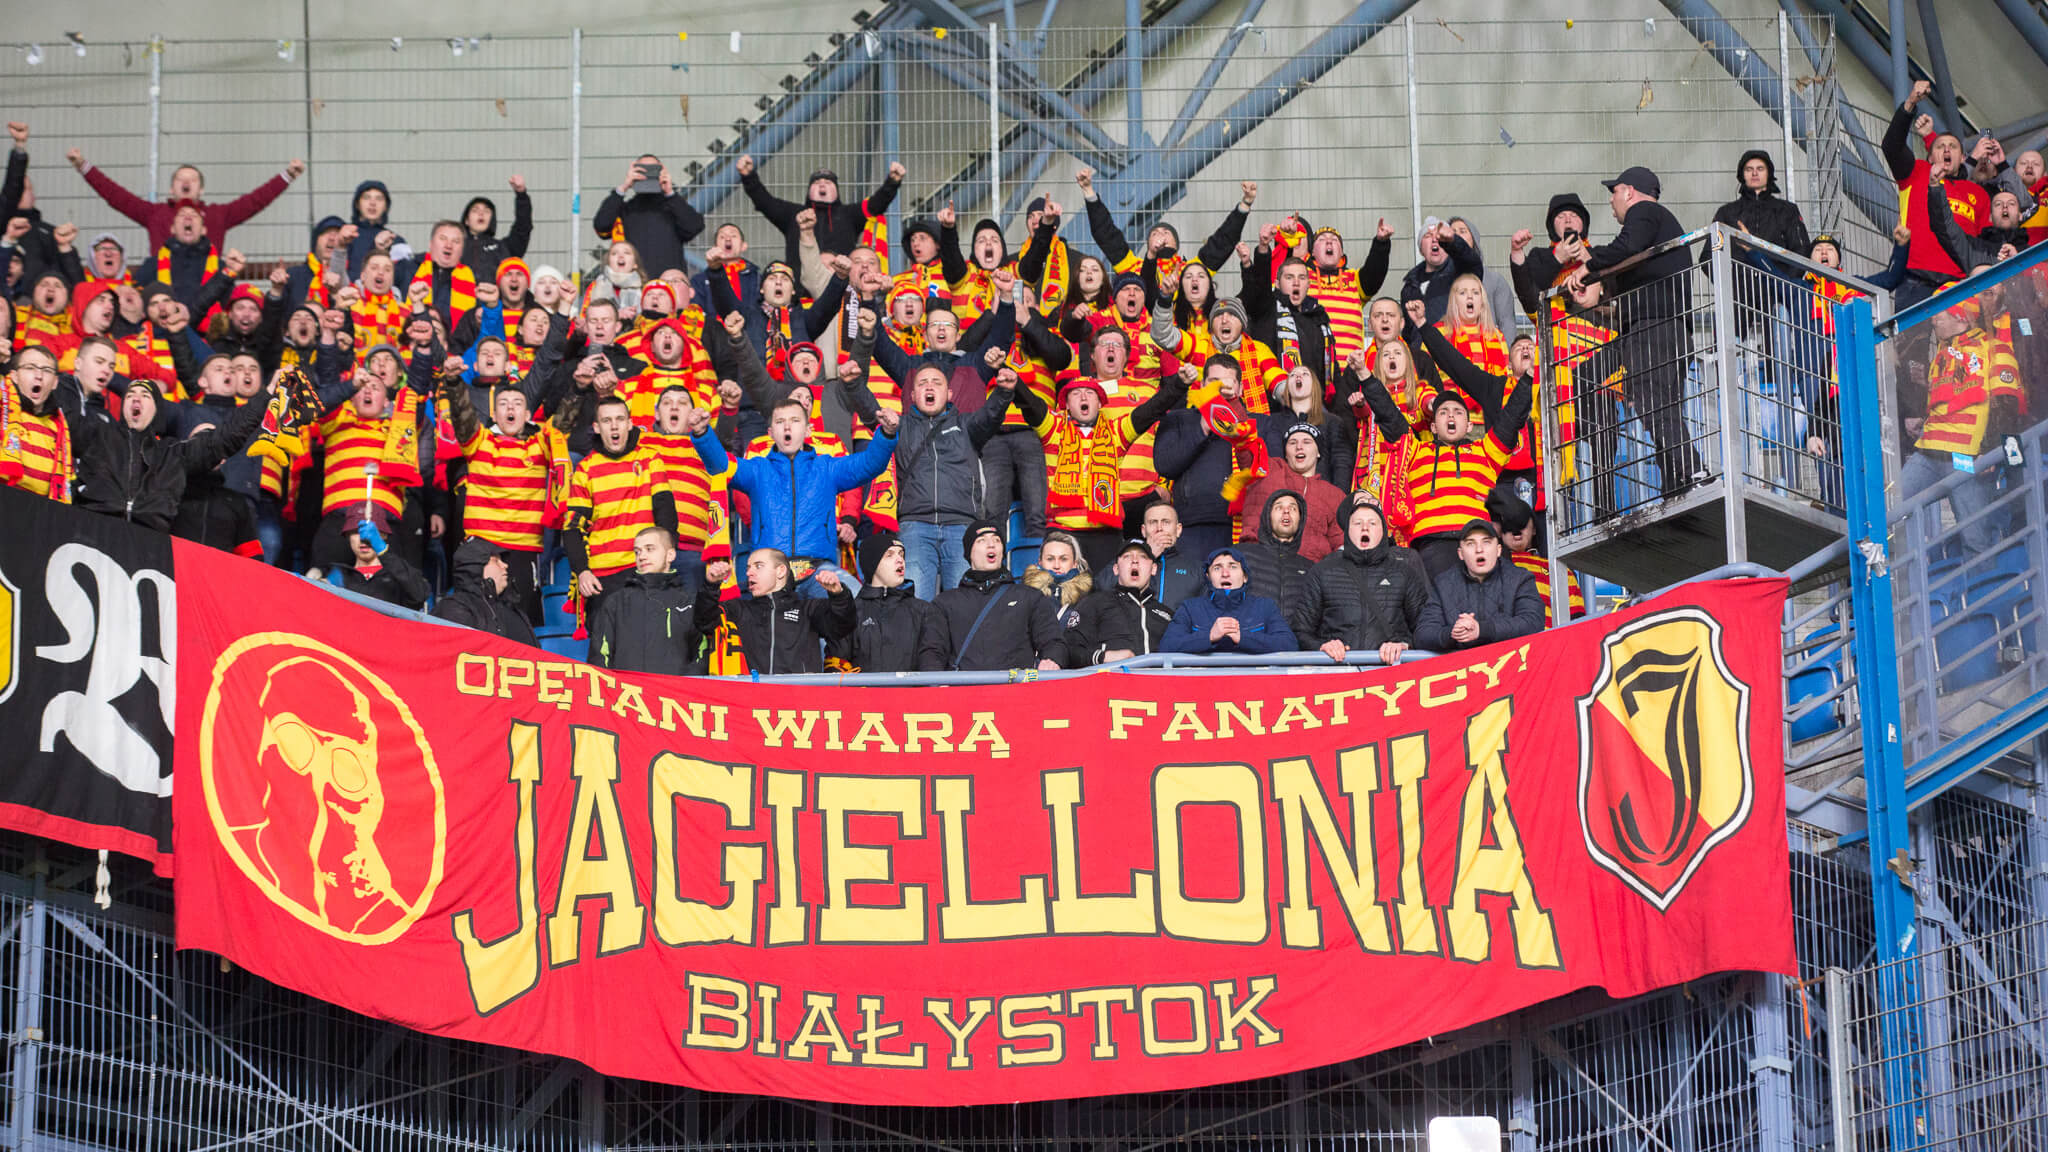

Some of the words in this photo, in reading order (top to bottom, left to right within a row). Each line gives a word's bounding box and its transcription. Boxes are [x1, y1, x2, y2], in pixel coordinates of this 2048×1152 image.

[455, 652, 729, 741] OPĘTANI
[752, 709, 1010, 758] WIARĄ
[1108, 643, 1531, 741] FANATYCY!
[450, 695, 1566, 1017] JAGIELLONIA
[681, 970, 1284, 1070] BIAŁYSTOK
